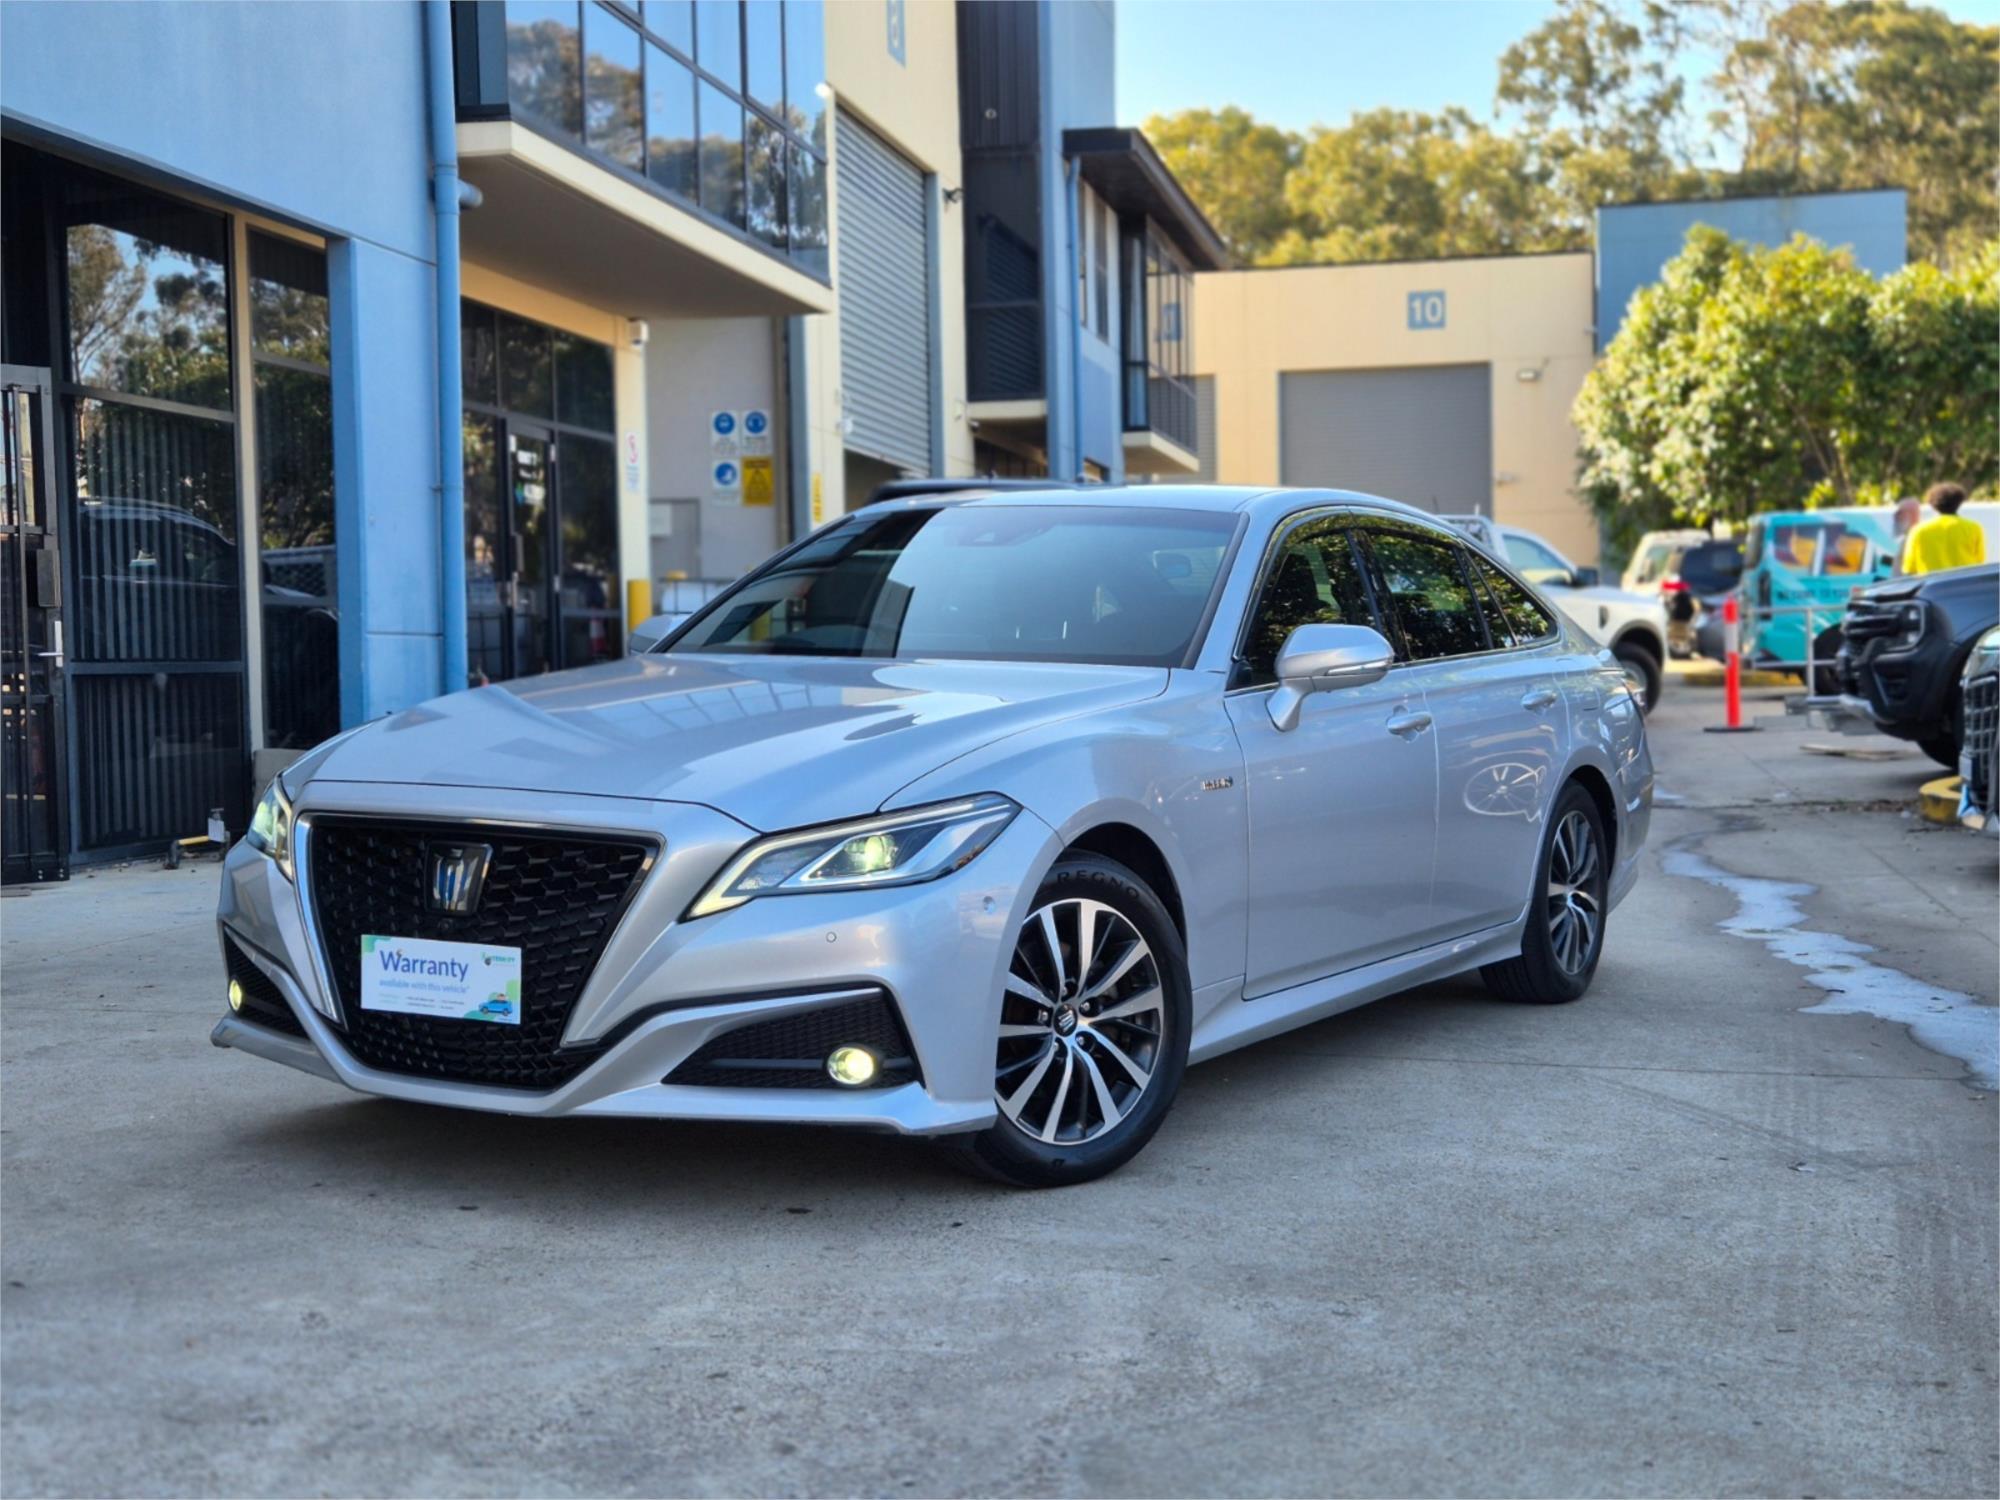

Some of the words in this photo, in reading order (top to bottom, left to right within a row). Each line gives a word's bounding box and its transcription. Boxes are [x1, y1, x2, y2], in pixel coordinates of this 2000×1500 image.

[1409, 296, 1442, 323] 10
[1056, 869, 1140, 899] REGNO
[379, 949, 469, 982] Warranty
